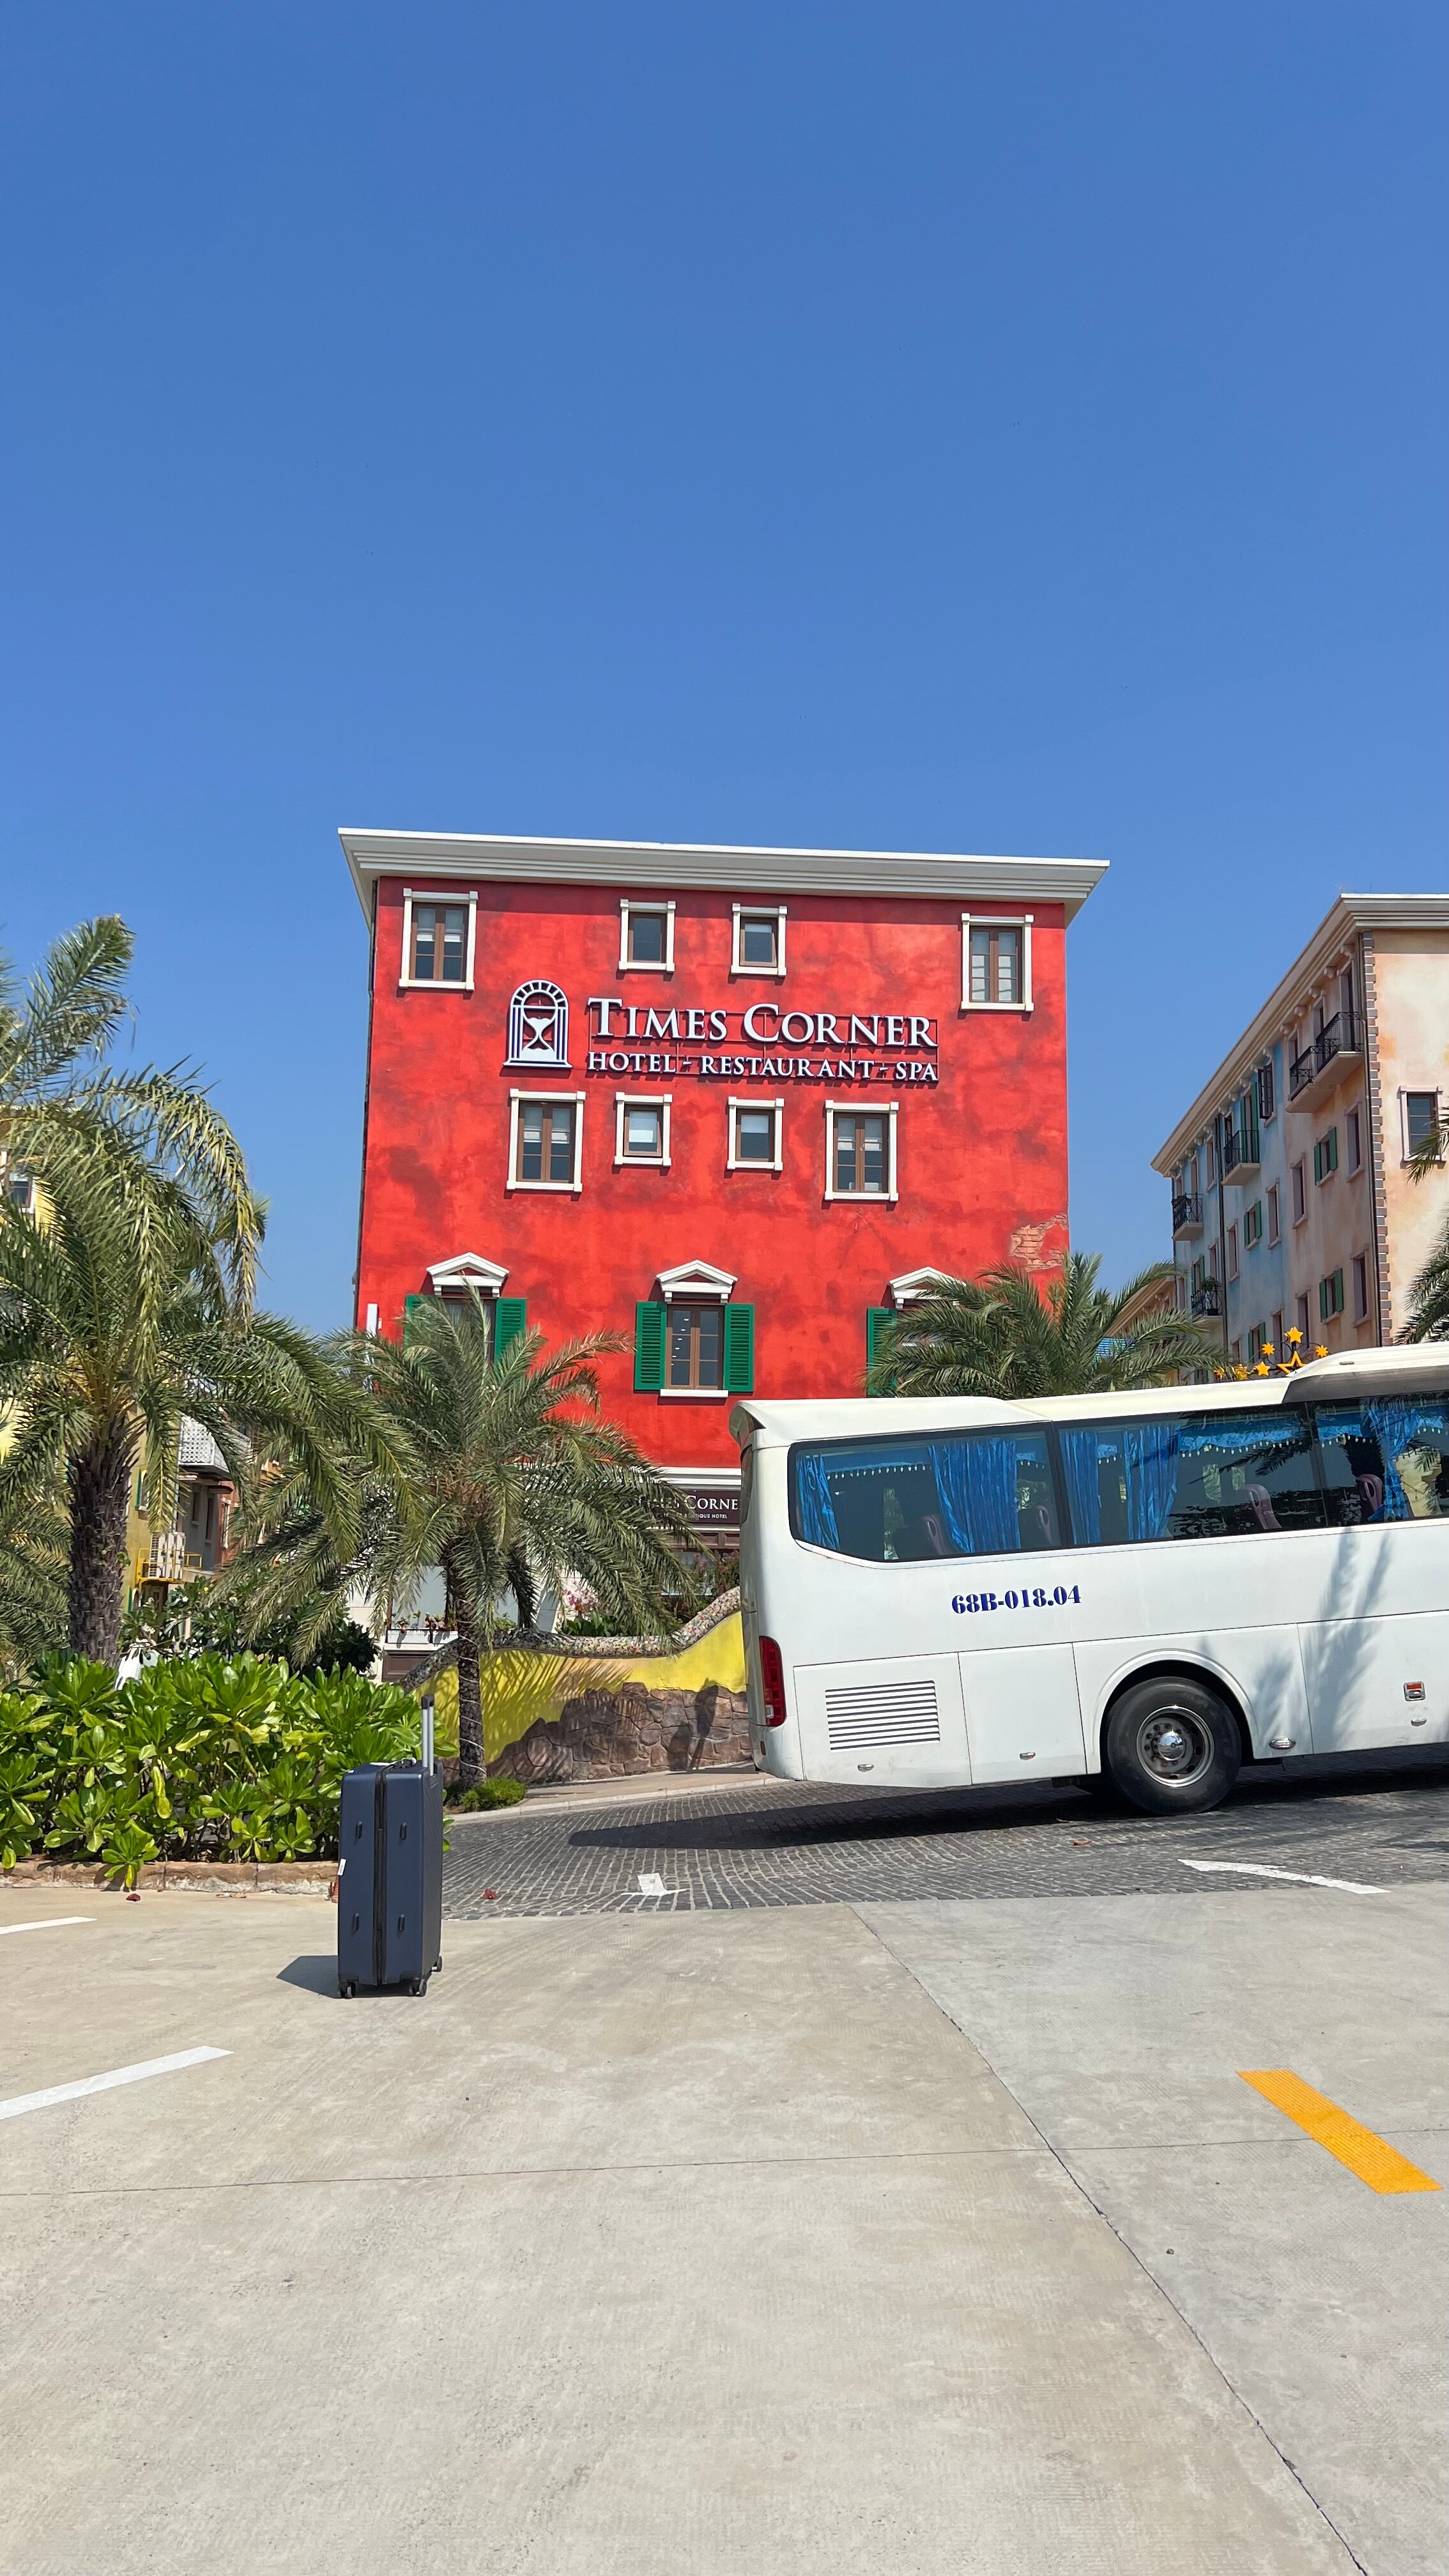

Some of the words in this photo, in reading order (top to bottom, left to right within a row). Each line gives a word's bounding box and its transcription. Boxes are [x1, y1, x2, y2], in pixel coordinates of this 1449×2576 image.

[588, 997, 727, 1041] TIMES
[744, 1003, 939, 1047] CORNER
[588, 1052, 676, 1073] HOTEL
[700, 1055, 875, 1078] RESTAURANT
[896, 1061, 939, 1081] SPA
[684, 1495, 739, 1510] CORNE
[951, 1584, 1082, 1614] 68B-018.04
